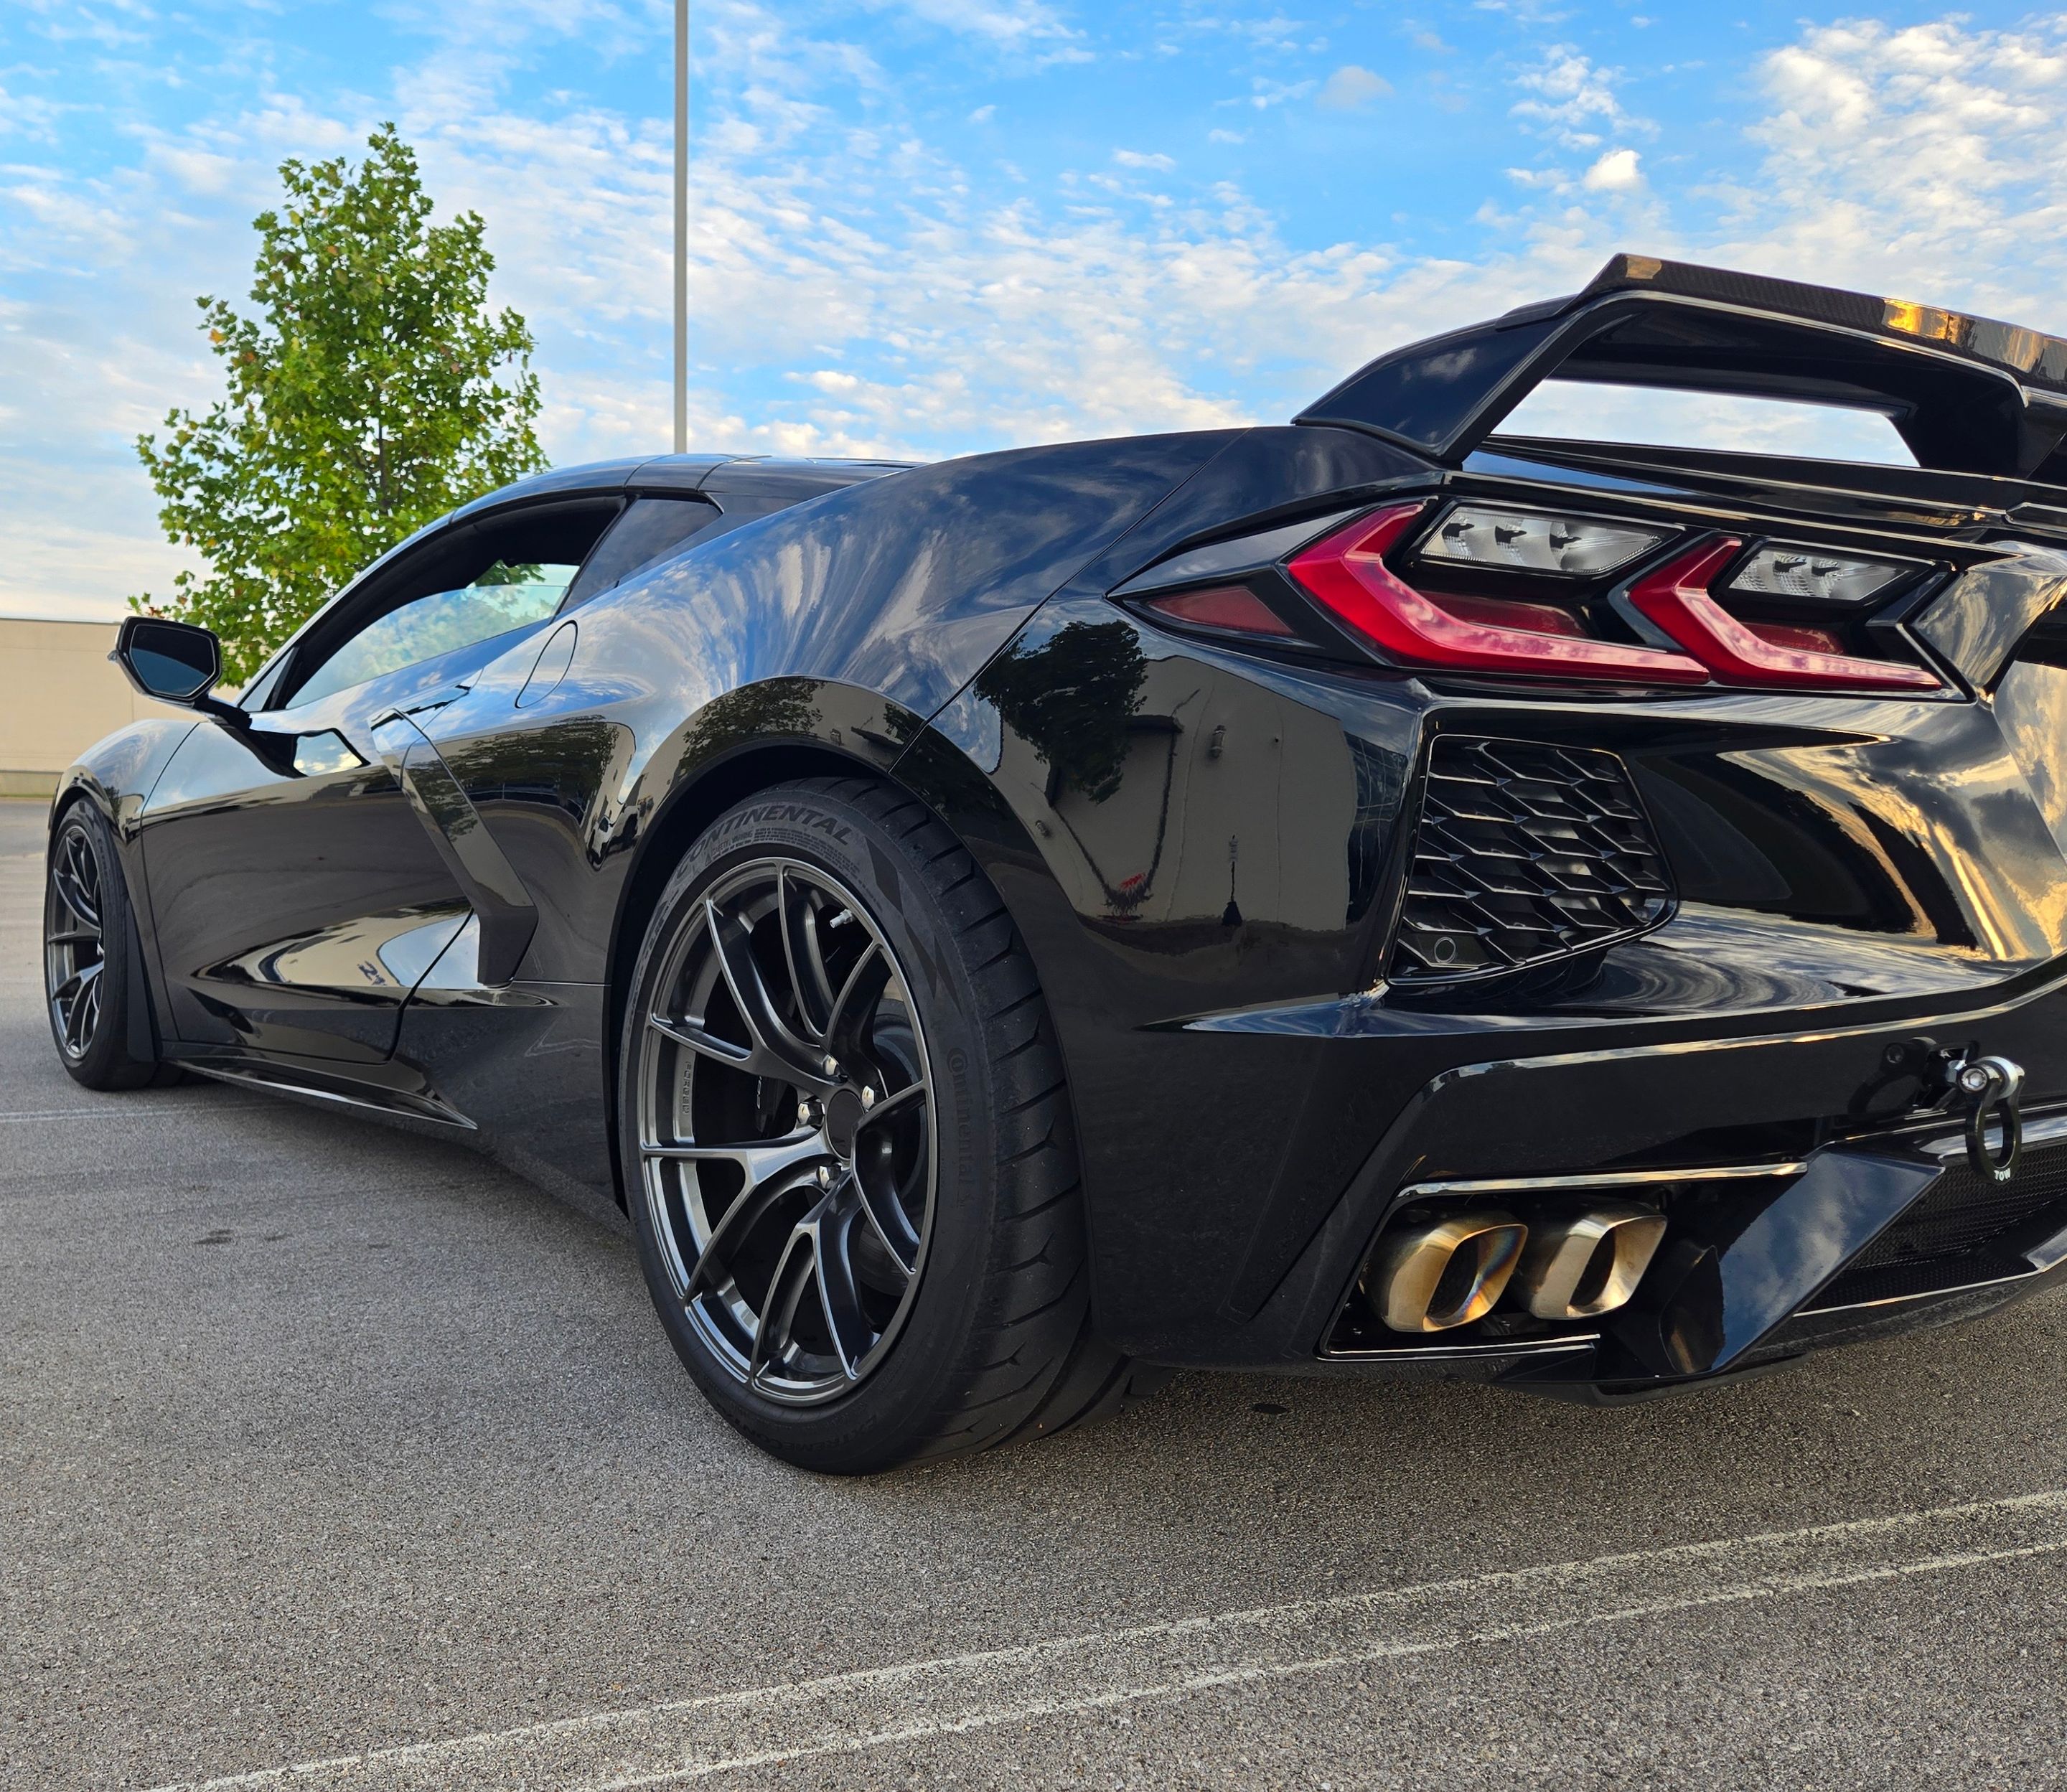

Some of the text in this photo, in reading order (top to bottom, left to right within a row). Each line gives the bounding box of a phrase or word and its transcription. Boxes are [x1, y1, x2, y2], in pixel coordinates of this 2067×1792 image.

[676, 804, 853, 880] CONTINENTAL
[946, 1047, 975, 1186] Continental
[1993, 1168, 2011, 1182] TOW
